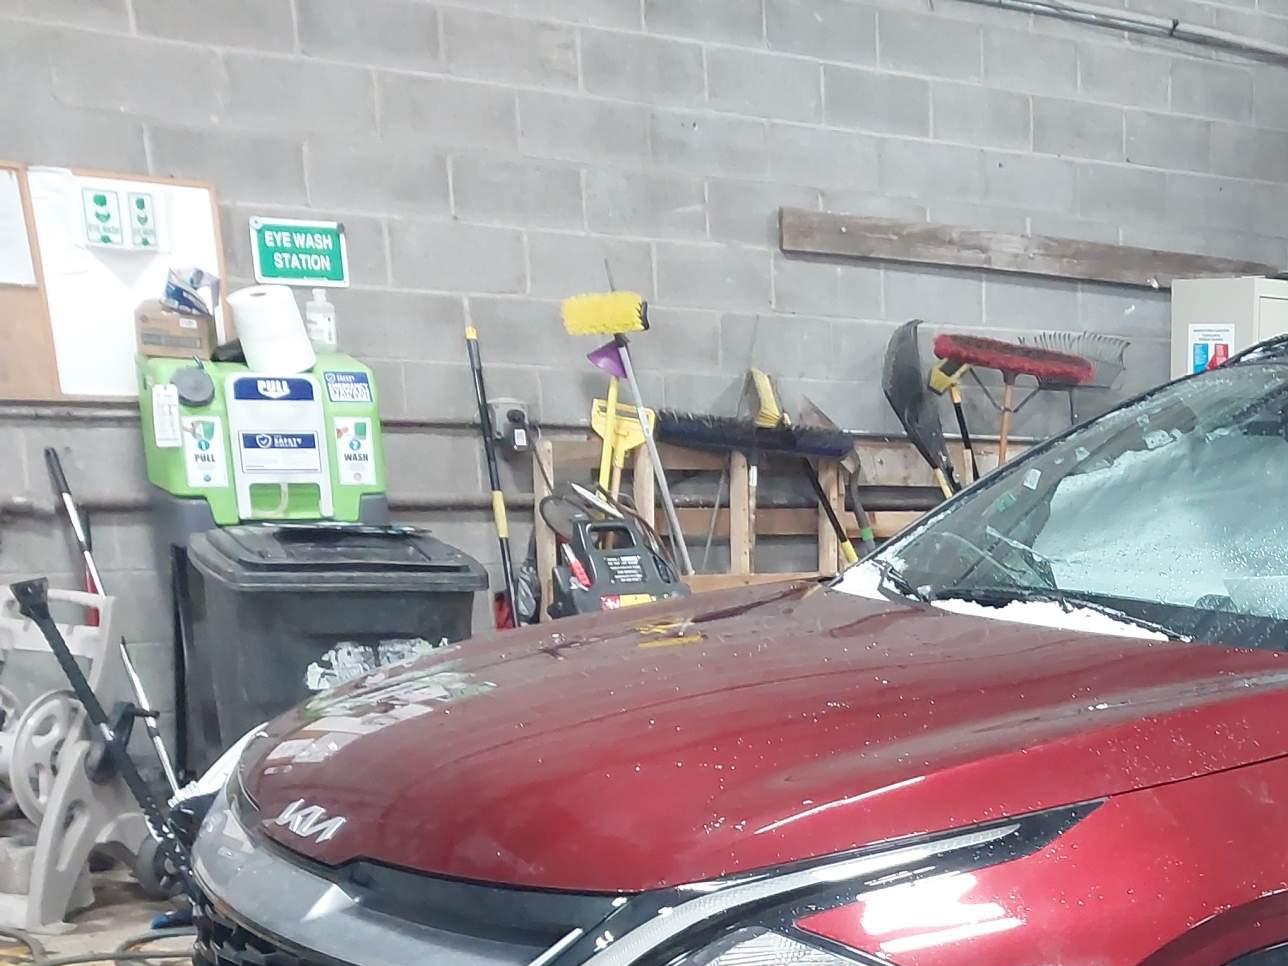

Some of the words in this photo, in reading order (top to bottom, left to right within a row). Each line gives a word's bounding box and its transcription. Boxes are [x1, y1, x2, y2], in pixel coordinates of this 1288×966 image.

[264, 230, 291, 248] EYE
[292, 232, 333, 250] WASH
[273, 252, 331, 271] STATION
[194, 453, 216, 463] PULL
[344, 453, 369, 462] WASH
[275, 798, 346, 843] KIA
